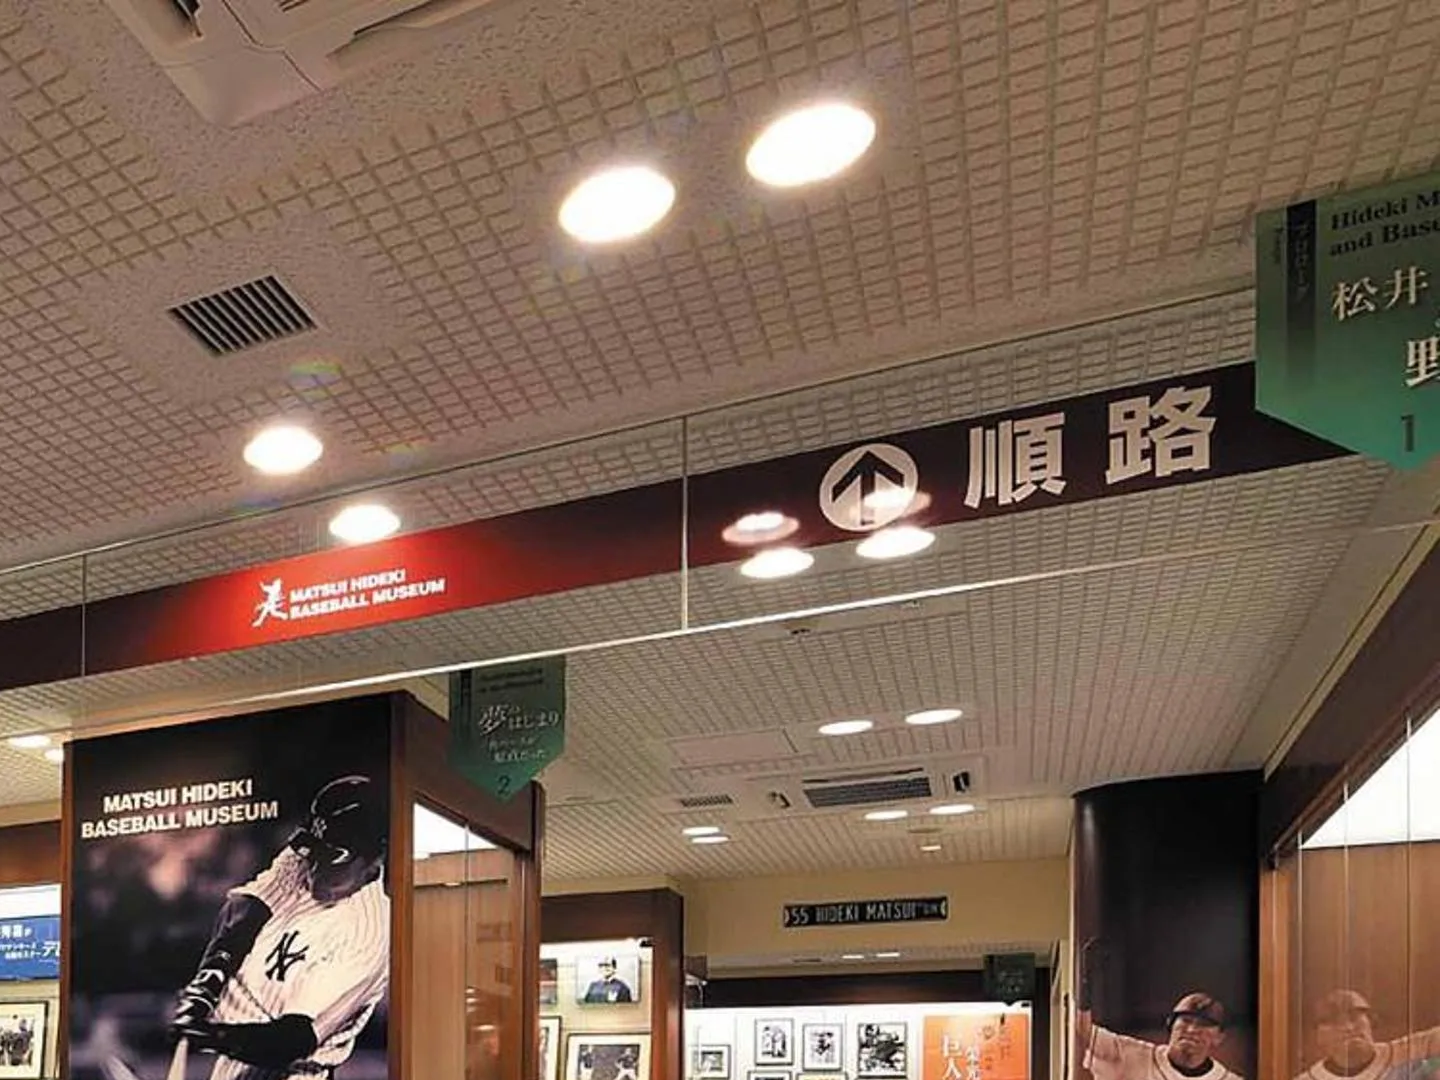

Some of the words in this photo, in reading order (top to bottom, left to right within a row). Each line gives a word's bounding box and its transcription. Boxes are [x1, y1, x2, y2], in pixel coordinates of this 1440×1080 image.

[1331, 197, 1408, 231] Hideki
[1329, 231, 1373, 257] and
[1332, 266, 1428, 321] 松井
[964, 386, 1216, 509] 順路
[290, 580, 348, 603] MATSUI
[349, 568, 406, 590] HIDEKI
[290, 593, 370, 620] BASEBALL
[372, 579, 446, 604] MUSEUM
[103, 788, 177, 813] MATSUI
[181, 779, 253, 805] HIDEKI
[497, 775, 511, 797] 2
[81, 814, 182, 839] BASEBALL
[185, 801, 279, 828] MUSEUM
[792, 907, 810, 925] 55
[815, 903, 859, 923] HIDEKI
[865, 900, 916, 920] MATSUI
